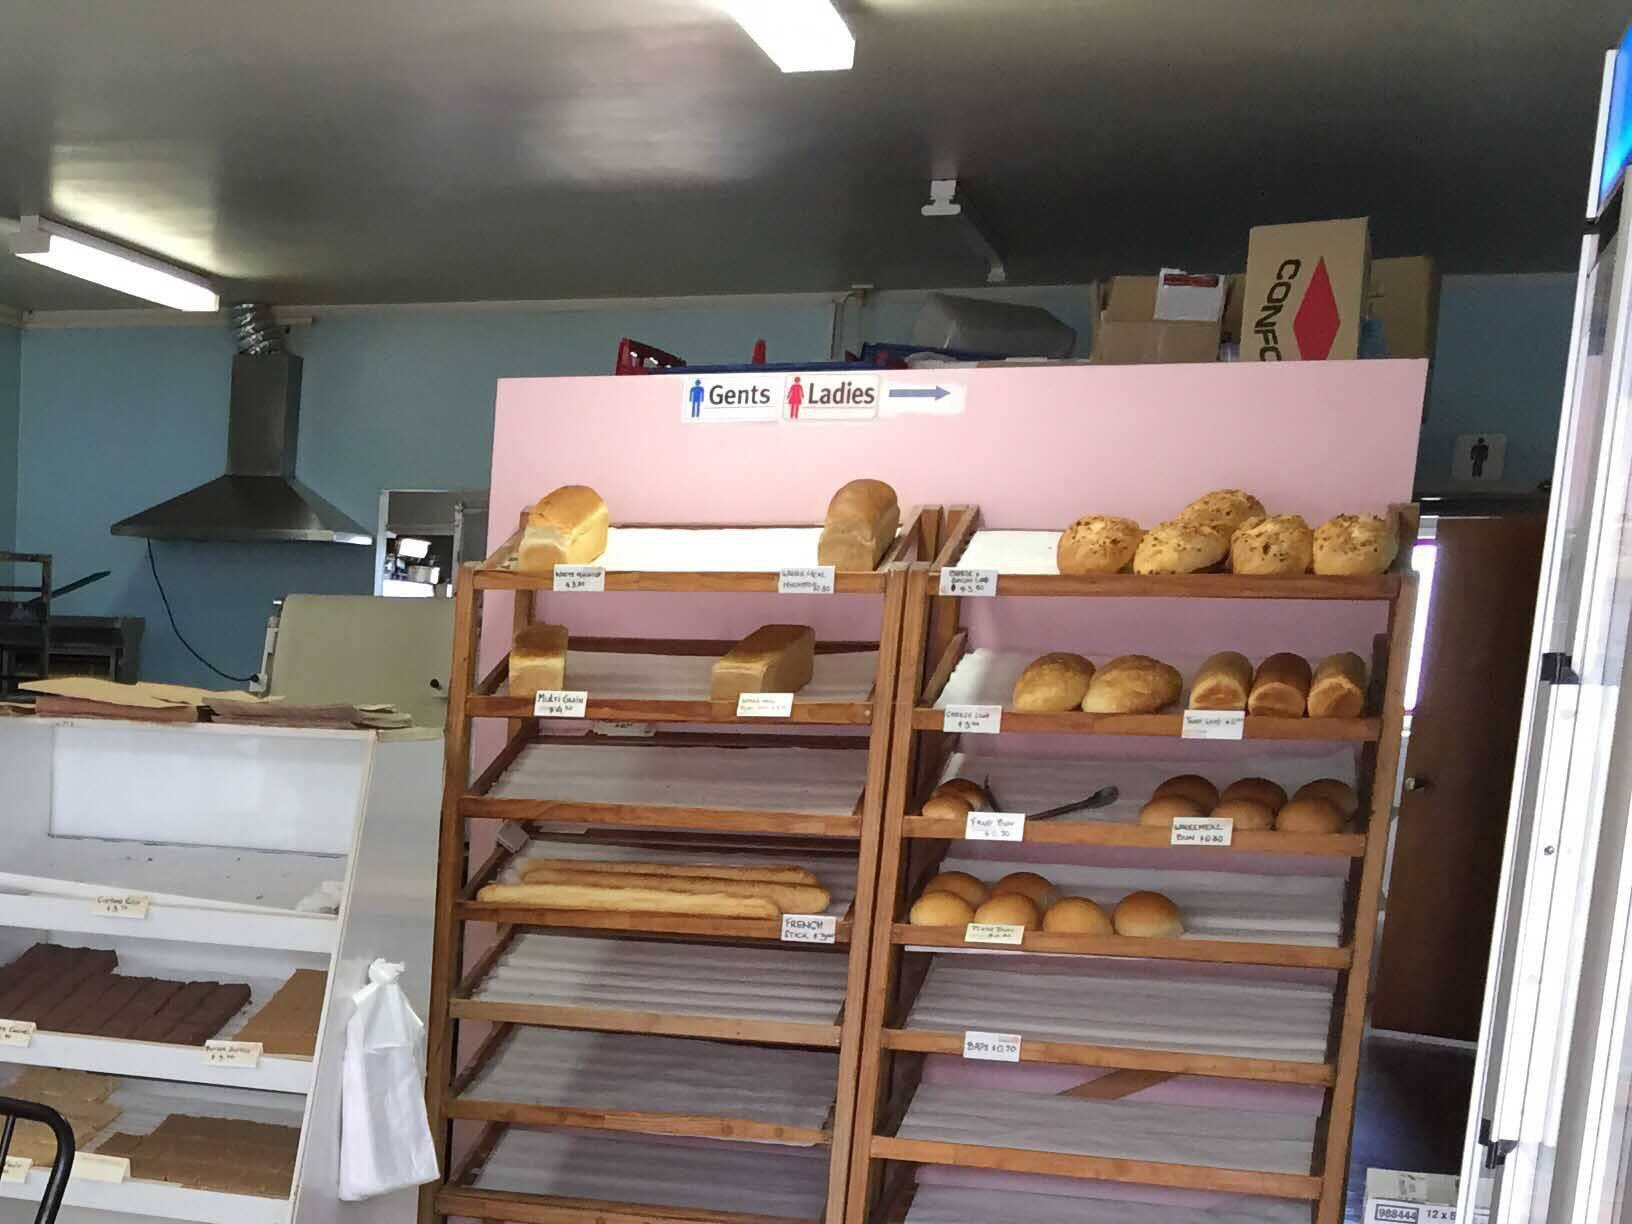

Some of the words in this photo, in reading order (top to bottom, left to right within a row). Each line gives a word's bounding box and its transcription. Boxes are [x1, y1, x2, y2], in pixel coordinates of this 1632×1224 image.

[709, 384, 771, 406] Gents
[808, 381, 876, 405] Ladies
[1426, 1209, 1438, 1219] 12
